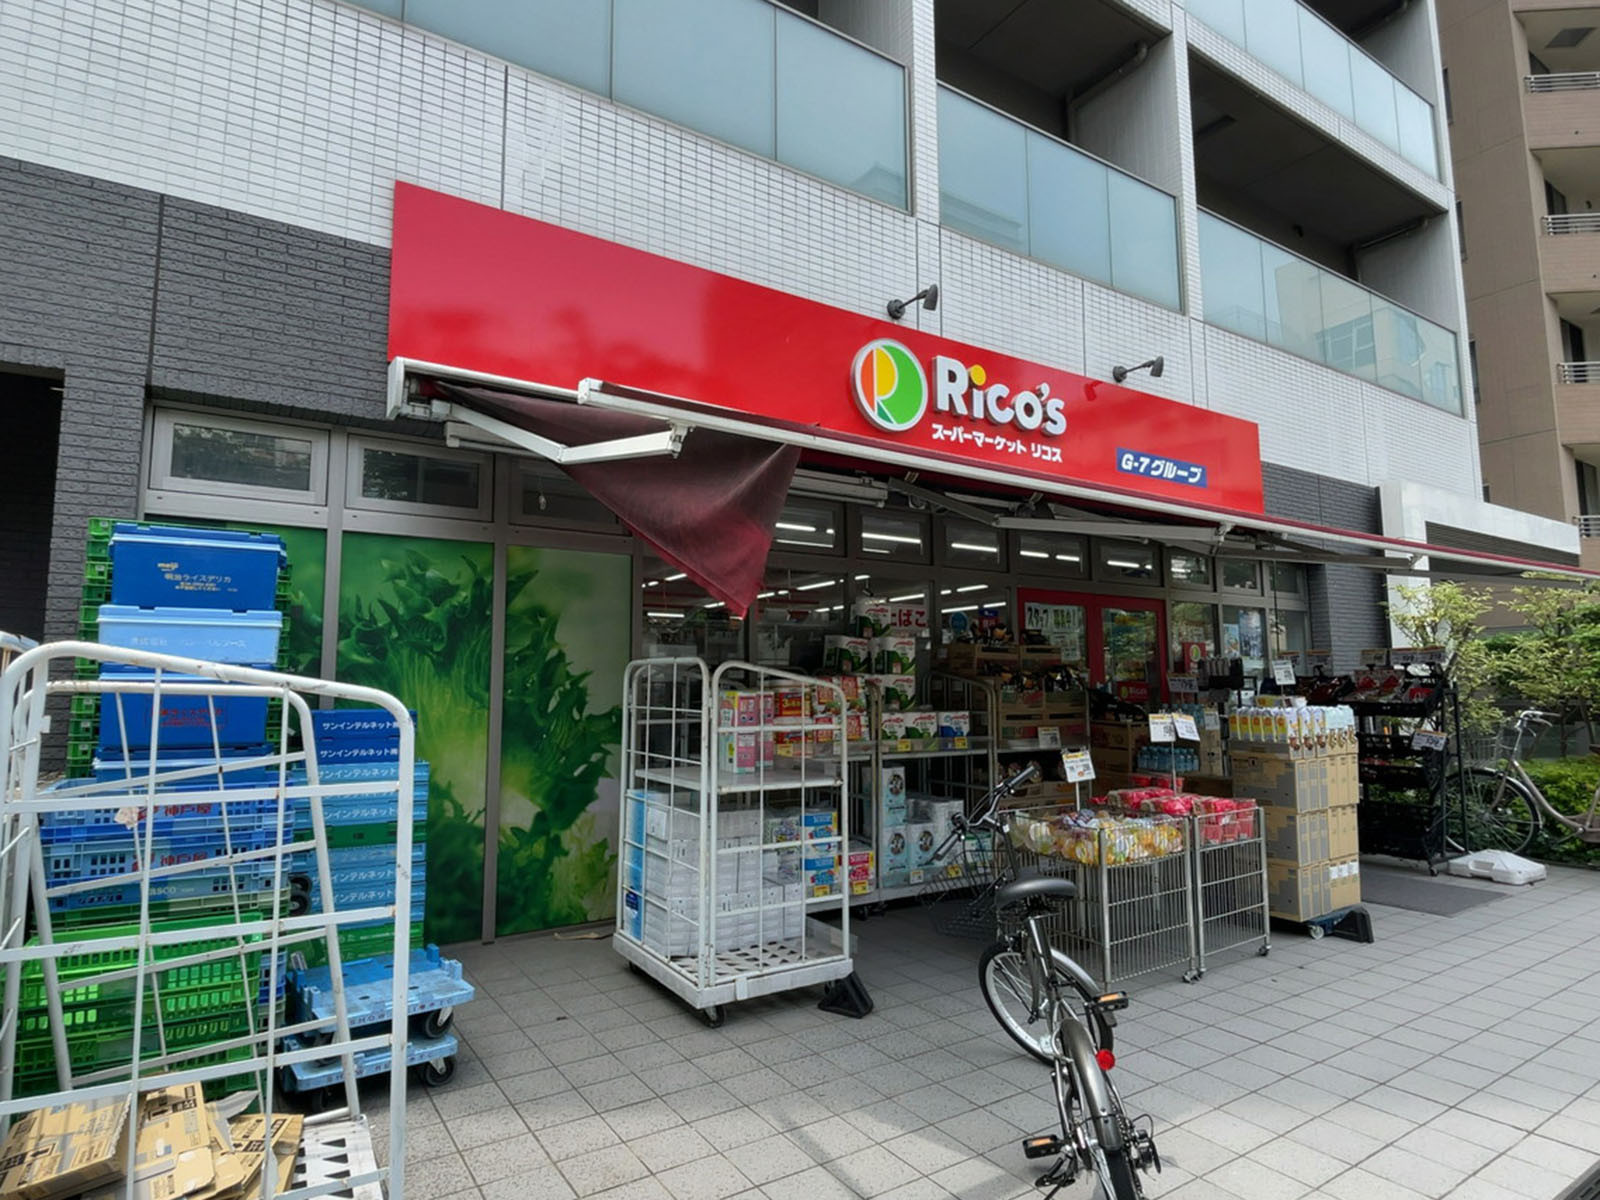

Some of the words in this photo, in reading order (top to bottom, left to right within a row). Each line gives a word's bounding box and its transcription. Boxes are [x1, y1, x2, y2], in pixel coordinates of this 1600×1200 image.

[931, 423, 1028, 455] スーパーマーケット
[1030, 442, 1064, 463] リコス
